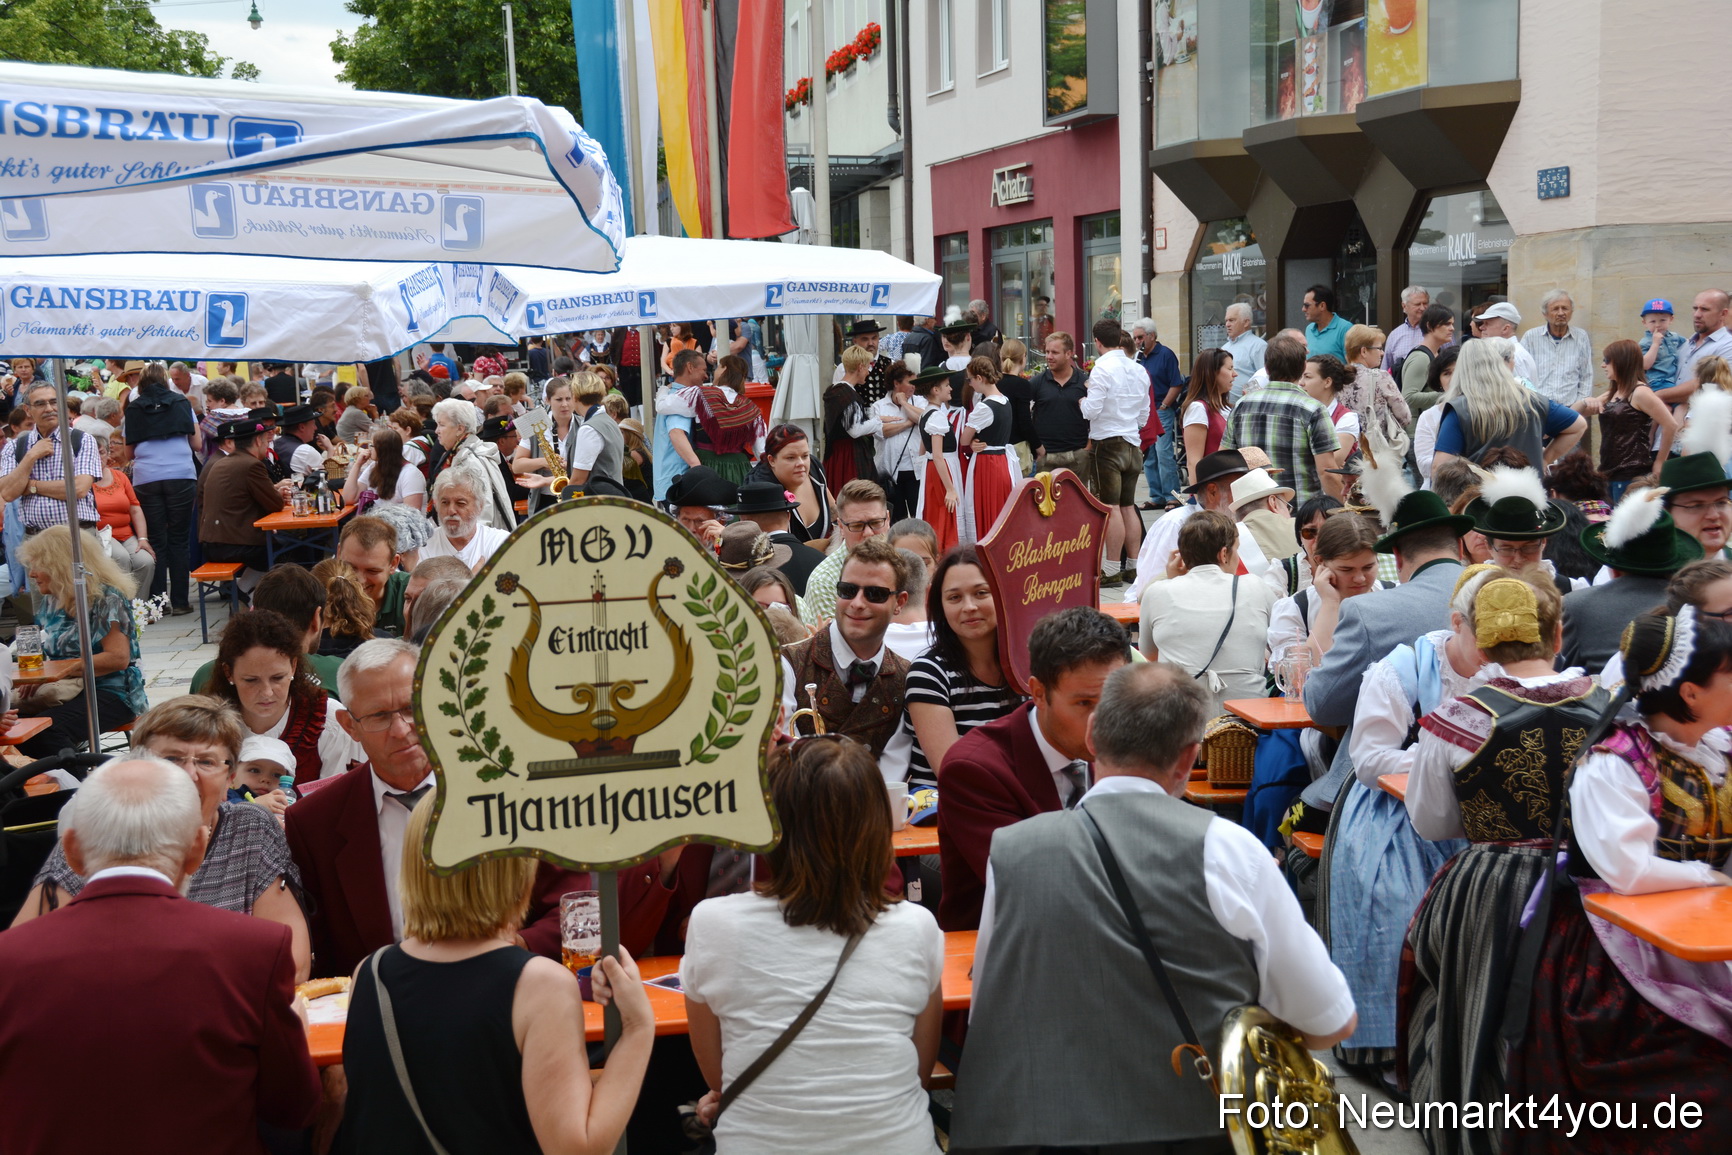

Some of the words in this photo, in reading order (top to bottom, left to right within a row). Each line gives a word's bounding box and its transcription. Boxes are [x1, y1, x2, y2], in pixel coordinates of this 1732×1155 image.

[46, 160, 114, 184] guter
[990, 162, 1029, 208] Achatz
[1408, 246, 1440, 256] Willkommen
[1448, 232, 1476, 260] RACKL
[1222, 253, 1242, 276] RACKL
[10, 285, 201, 313] GANSBRÄU
[546, 291, 634, 311] GANSBRÄU
[786, 281, 871, 293] GANSBRÄU
[10, 320, 95, 338] Neumarkt's
[97, 325, 136, 339] guter
[136, 324, 200, 341] Schluck
[1006, 523, 1092, 573] Blaskapelle
[1021, 571, 1083, 606] Berngau
[547, 620, 650, 656] Eintracht
[466, 778, 739, 845] Thannhausen
